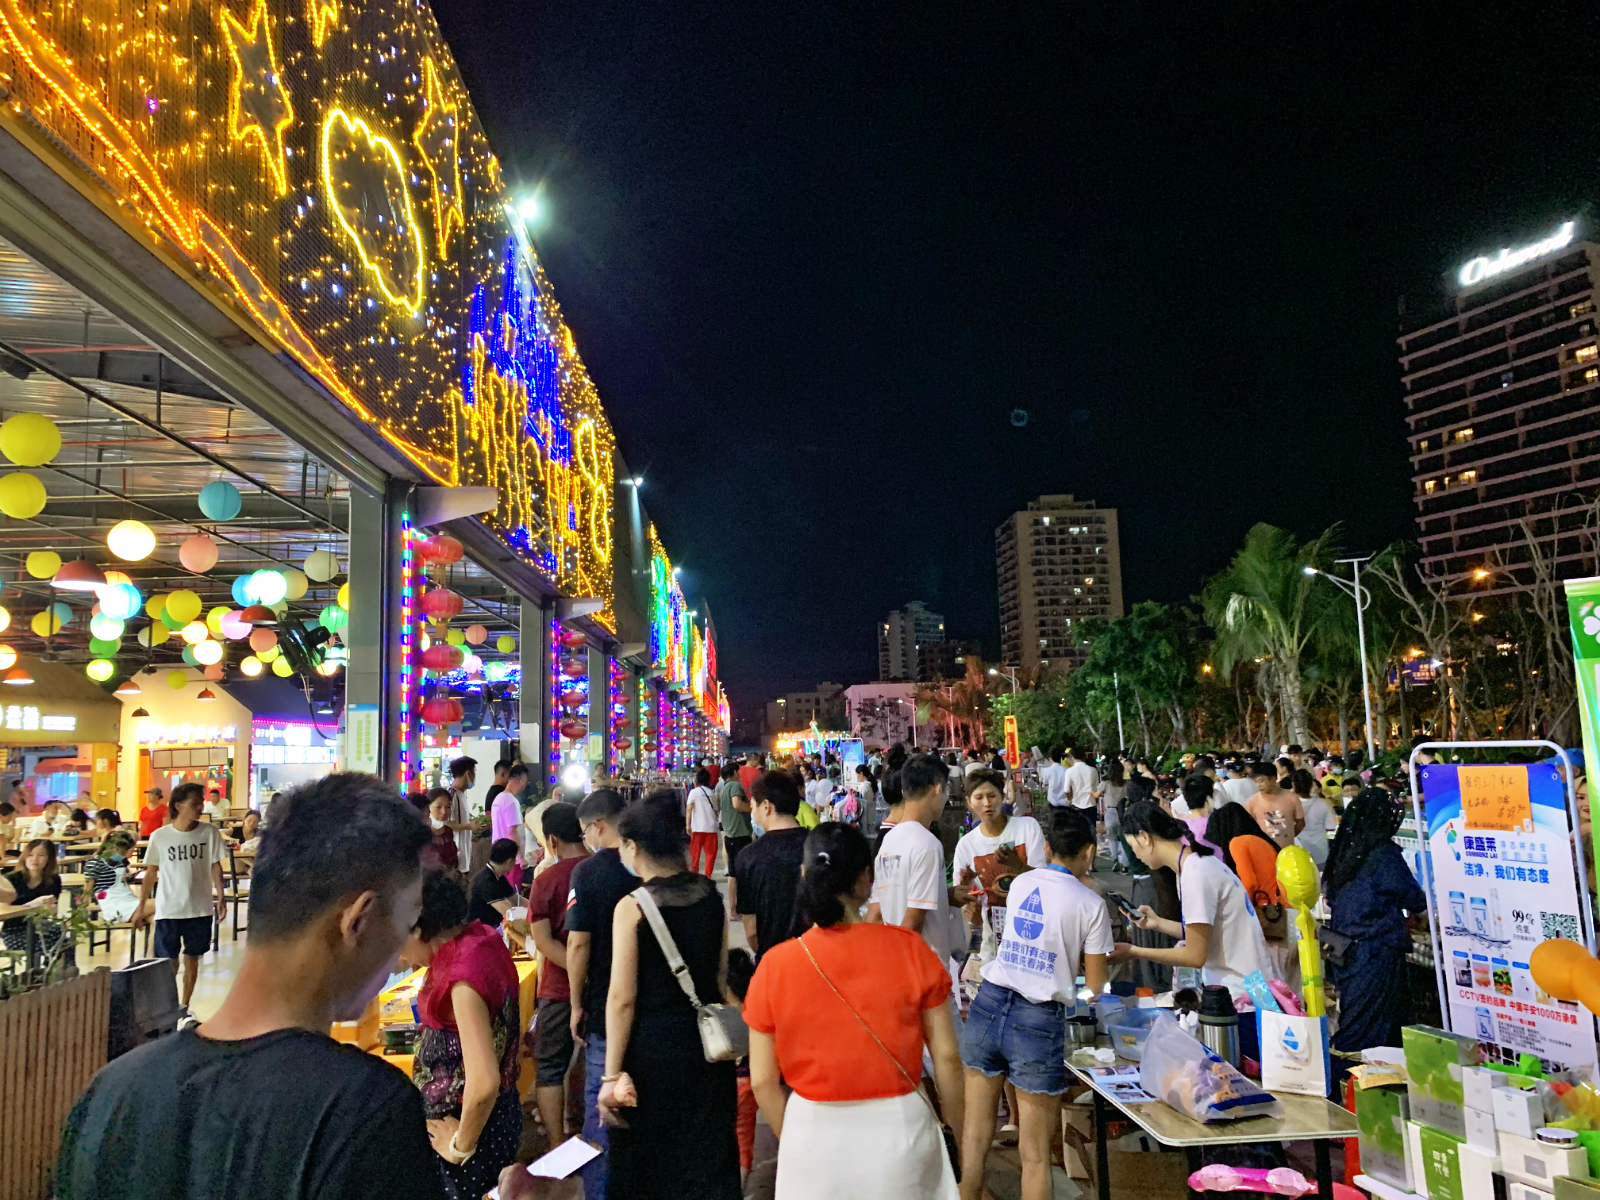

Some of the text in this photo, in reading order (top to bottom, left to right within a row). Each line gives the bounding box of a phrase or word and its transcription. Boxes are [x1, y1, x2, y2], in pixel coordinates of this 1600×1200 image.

[1458, 221, 1575, 286] Oakwood
[168, 843, 206, 861] SHOT
[1463, 836, 1497, 852] 康盛莱
